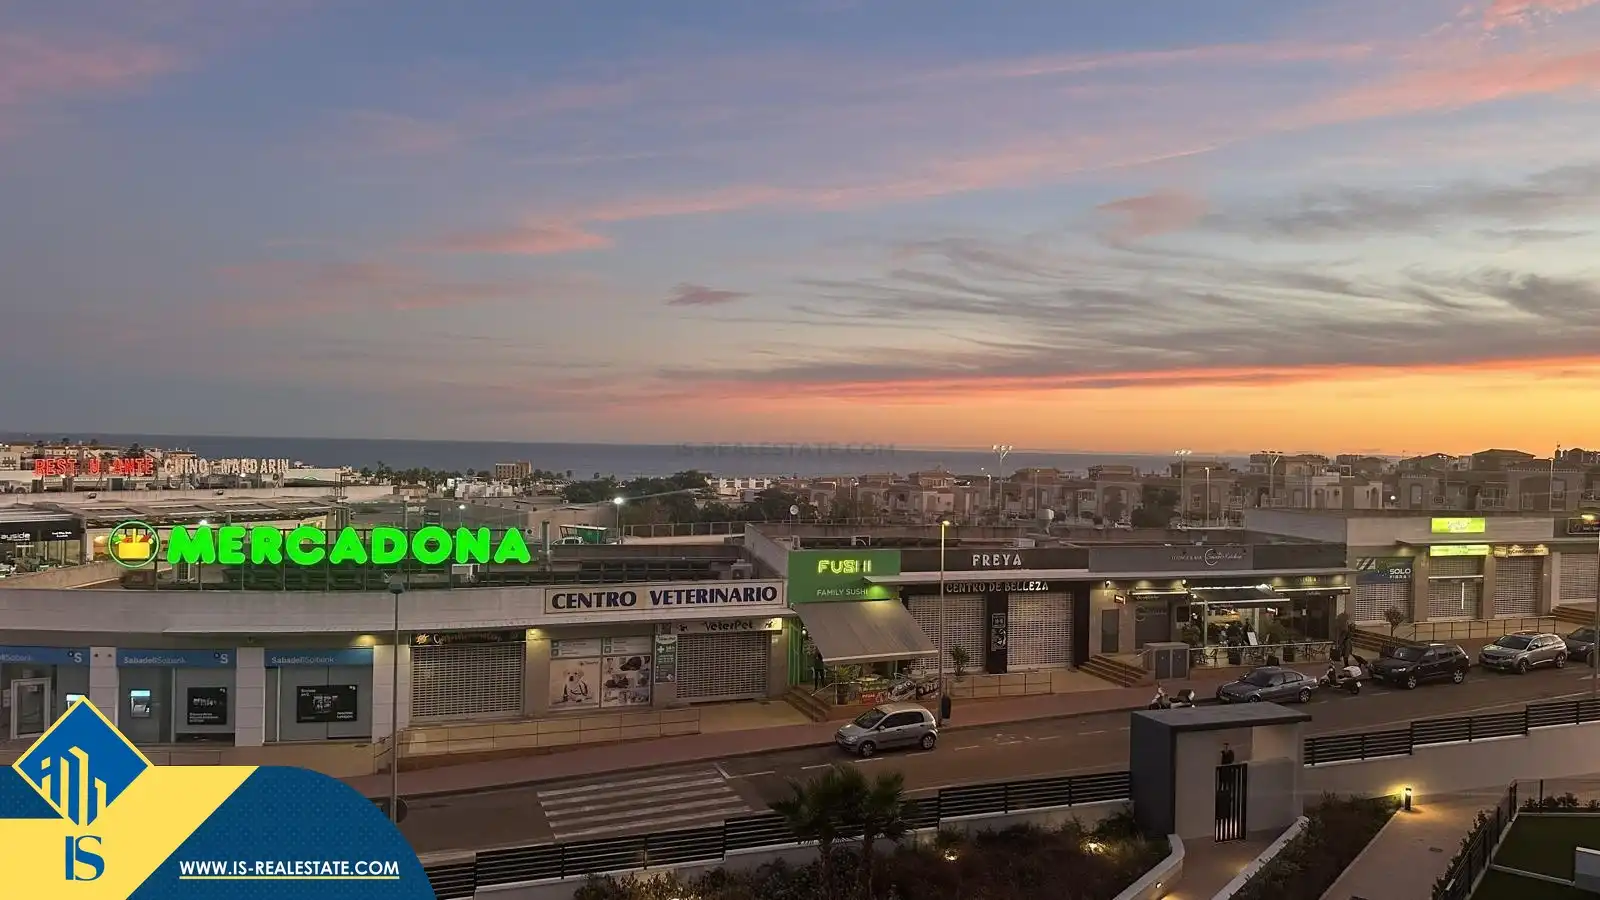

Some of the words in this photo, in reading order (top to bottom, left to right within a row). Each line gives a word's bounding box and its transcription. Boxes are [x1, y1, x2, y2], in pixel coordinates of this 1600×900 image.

[166, 524, 532, 566] MERCADONA
[972, 553, 1022, 567] FREYA
[816, 588, 845, 597] FAMILY
[846, 588, 869, 596] SUSHI
[946, 582, 986, 593] CENTRO
[989, 582, 1002, 592] DE
[1004, 581, 1049, 592] BELLEZA
[551, 590, 637, 610] CENTRO
[649, 585, 779, 606] VETERINARIO
